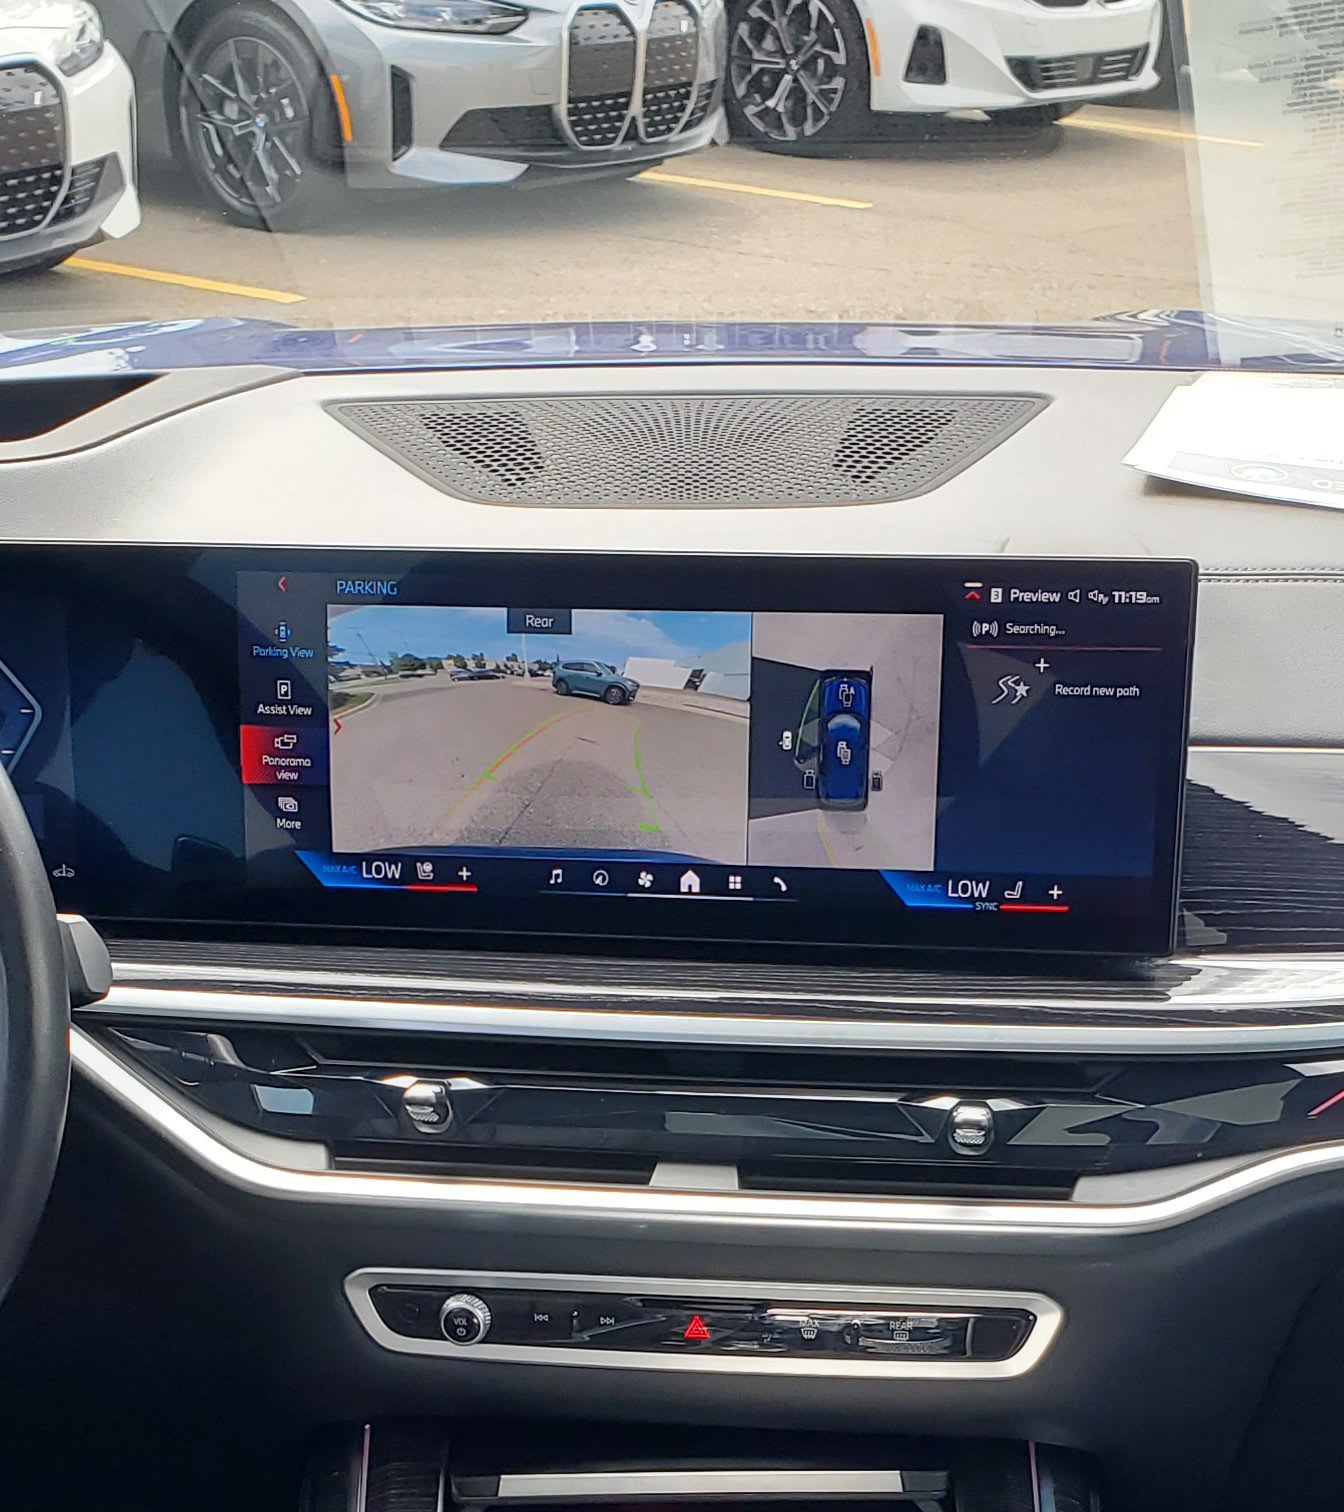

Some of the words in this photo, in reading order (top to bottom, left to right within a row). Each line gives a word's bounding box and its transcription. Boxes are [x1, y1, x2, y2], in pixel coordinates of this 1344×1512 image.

[336, 580, 398, 597] PARKING
[1010, 589, 1061, 602] Preview
[525, 614, 555, 629] Rear
[253, 646, 287, 659] Parking
[289, 646, 314, 658] View
[1055, 684, 1091, 696] Record
[1093, 686, 1114, 696] new
[1116, 685, 1140, 698] path
[257, 703, 287, 715] Assist
[288, 705, 312, 715] View
[262, 756, 311, 767] Panorama
[276, 769, 299, 780] view
[277, 817, 301, 829] More
[361, 861, 401, 880] LOW
[948, 879, 990, 898] LOW
[975, 901, 999, 912] SYNC
[453, 1317, 468, 1326] VOL
[889, 1321, 914, 1331] REAR
